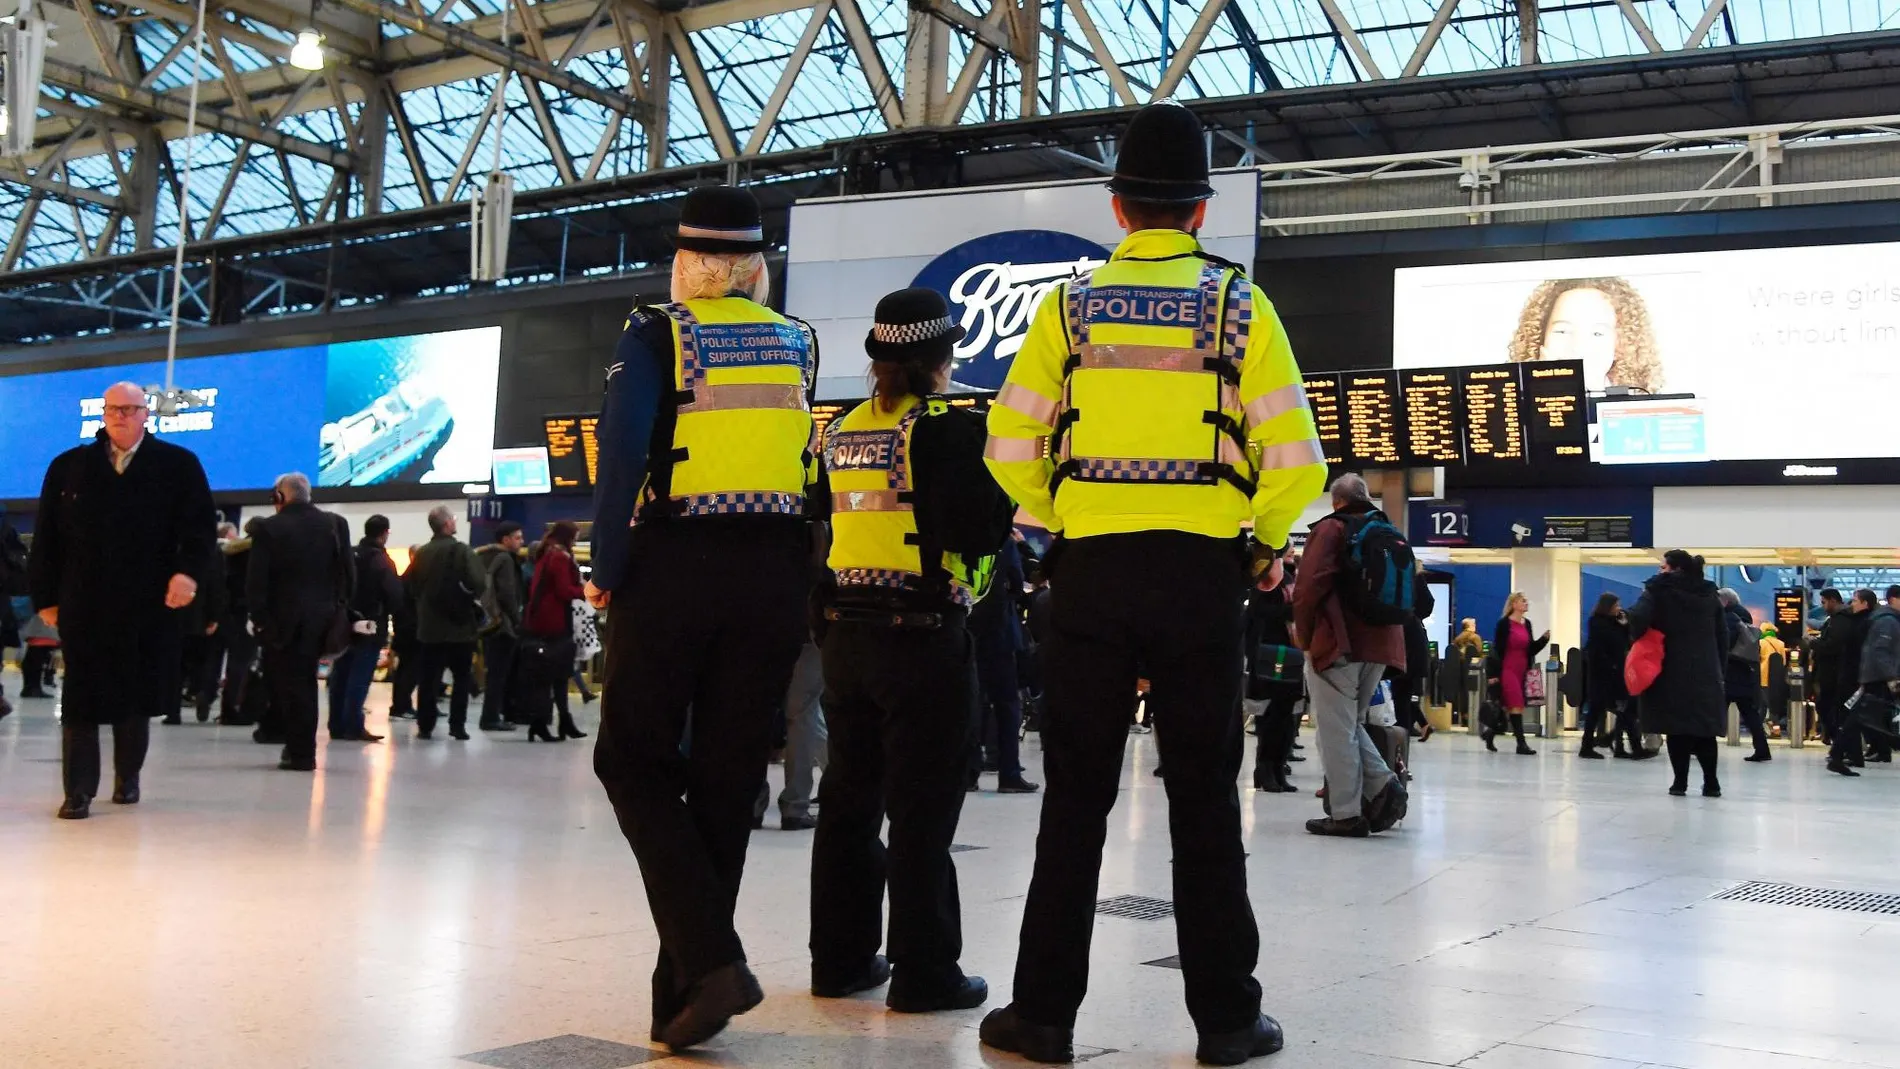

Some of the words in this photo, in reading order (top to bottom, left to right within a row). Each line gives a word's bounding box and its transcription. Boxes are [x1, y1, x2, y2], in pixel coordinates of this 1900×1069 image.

[1090, 289, 1130, 298] BRITISH
[1134, 290, 1198, 299] TRANSPORT
[1748, 285, 1834, 306] Where
[1846, 279, 1900, 310] girls
[1086, 298, 1197, 322] POLICE
[730, 326, 774, 335] TRANSPORT
[702, 337, 739, 348] POLICE
[742, 336, 802, 348] COMMUNITY
[709, 351, 757, 362] SUPPORT
[761, 350, 801, 361] OFFICER
[471, 499, 481, 517] 11
[1431, 512, 1457, 534] 12
